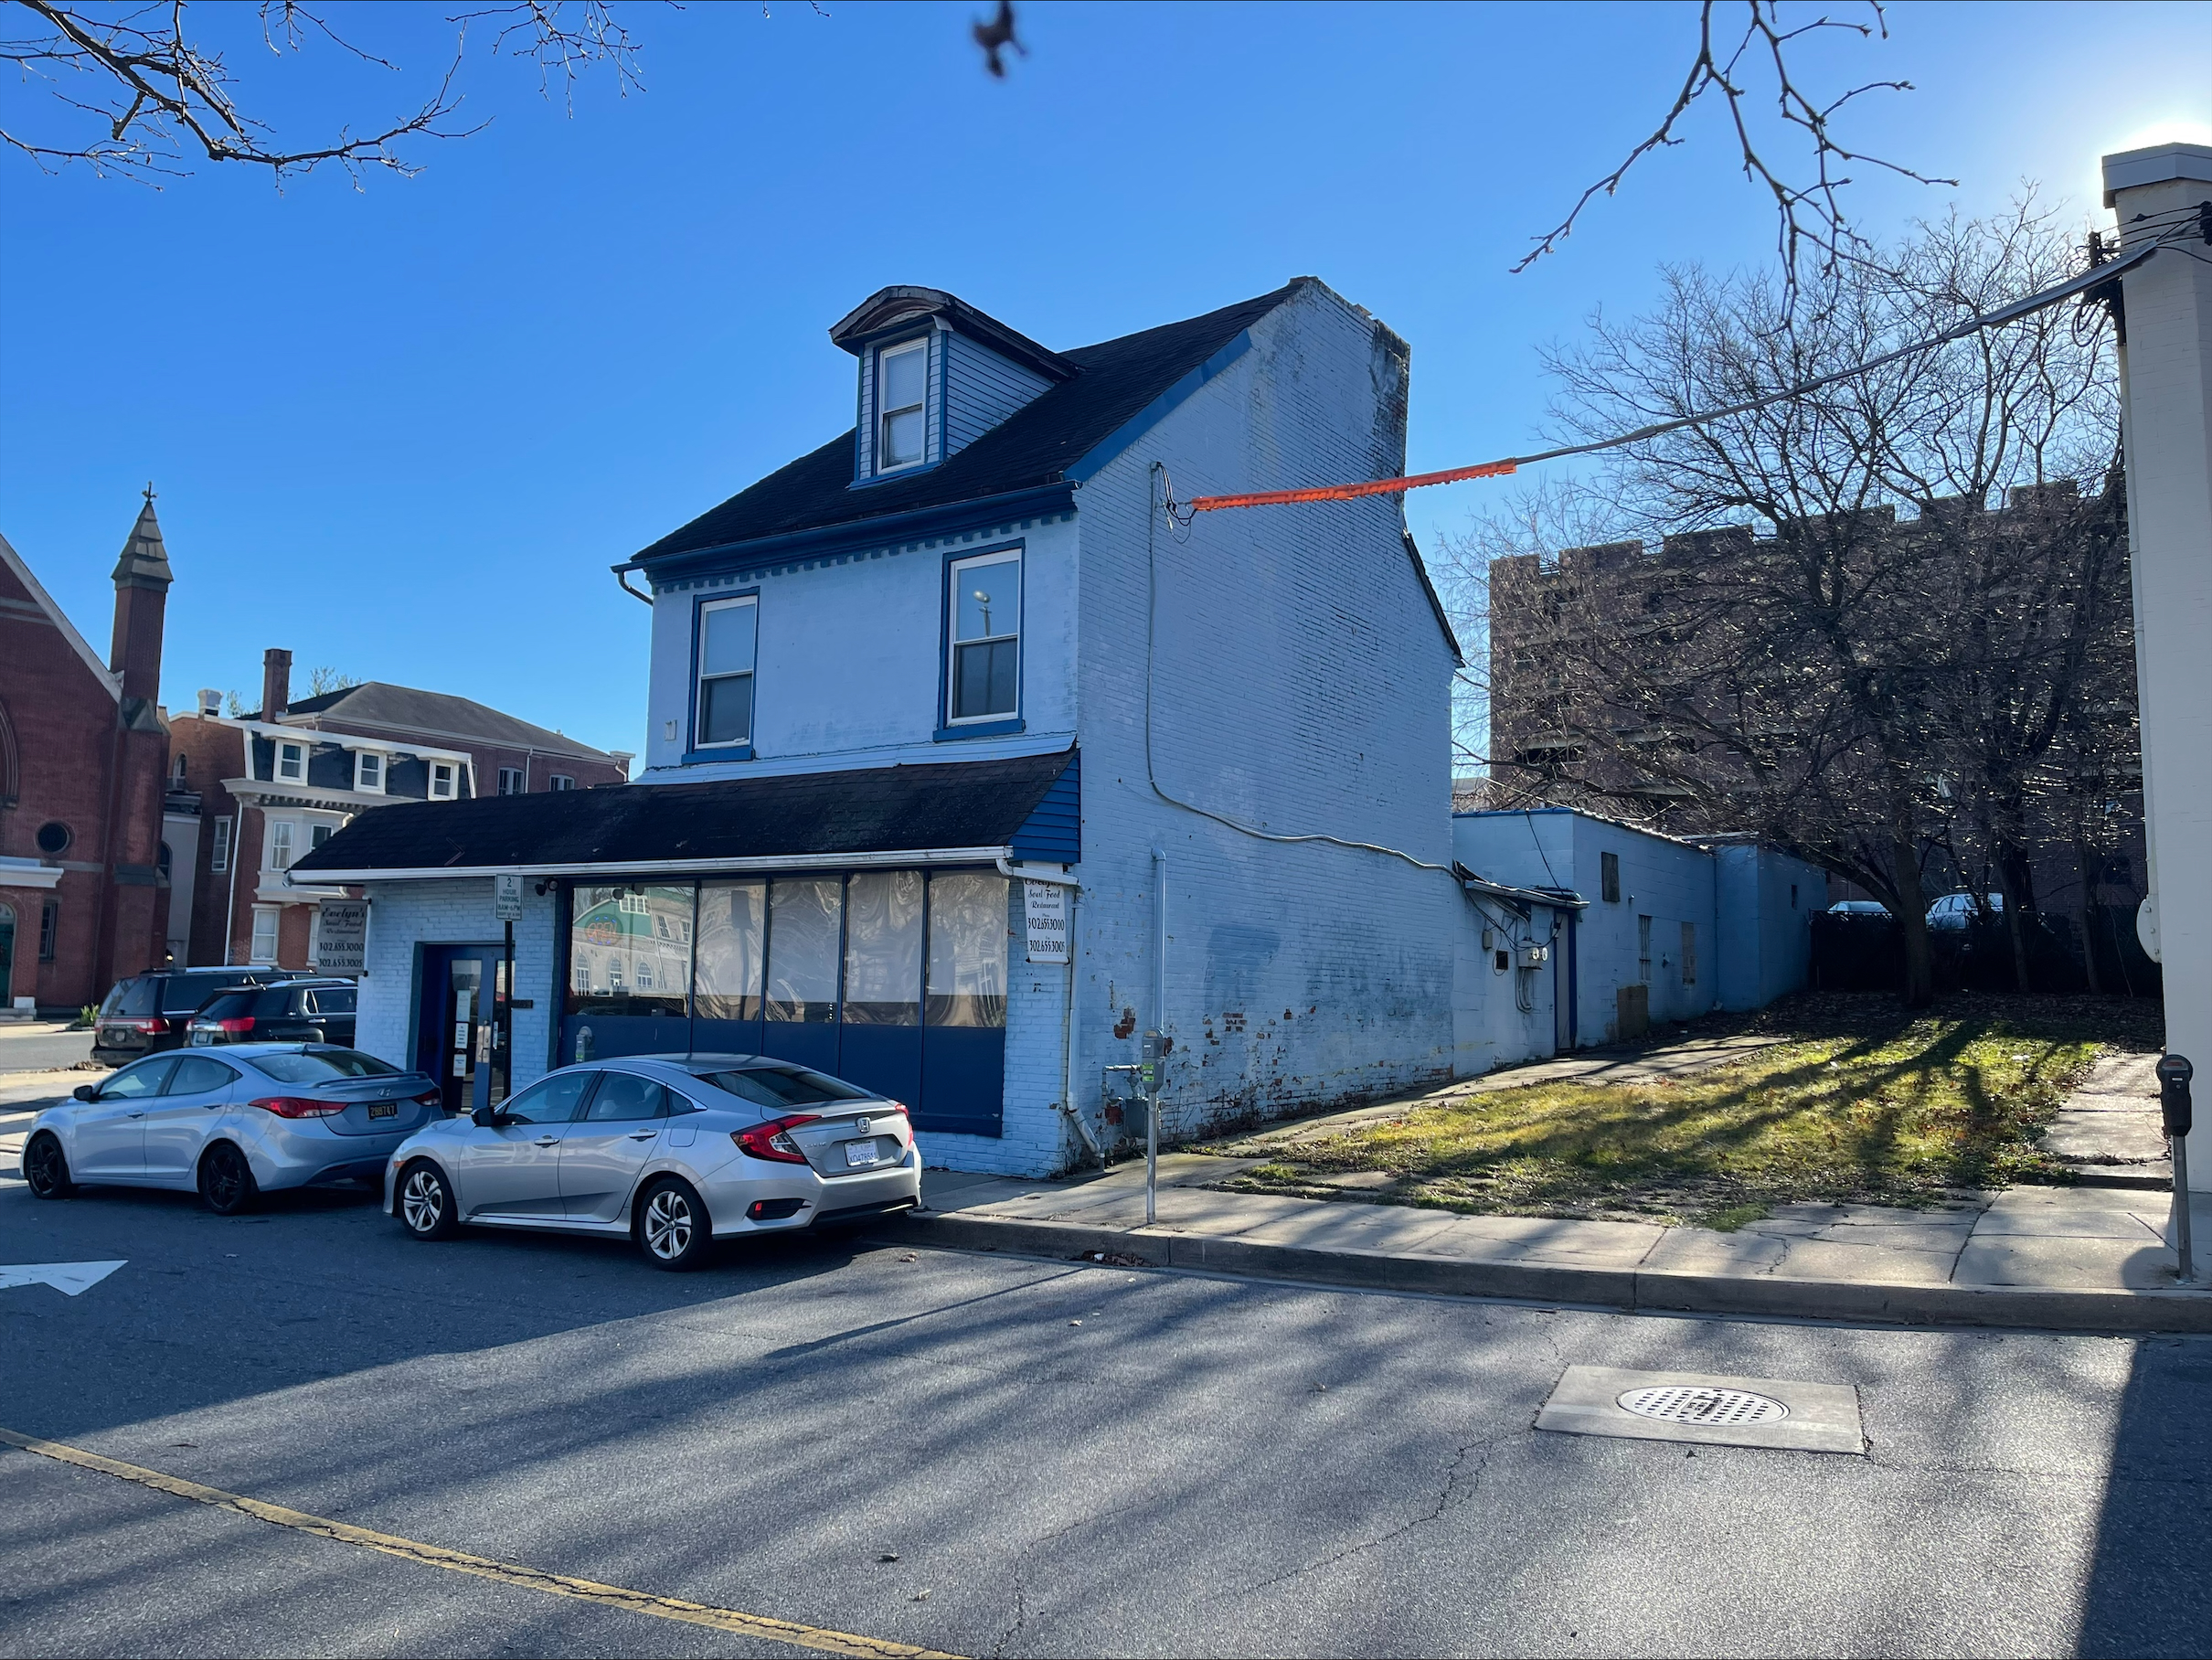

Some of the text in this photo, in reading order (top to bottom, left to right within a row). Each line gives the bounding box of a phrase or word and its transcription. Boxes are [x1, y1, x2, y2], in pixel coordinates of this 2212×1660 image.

[506, 877, 512, 888] 2
[499, 895, 519, 903] PARKING
[1027, 889, 1061, 900] Soul Food
[322, 907, 365, 920] Evelyn's
[324, 919, 363, 928] Soul Food
[586, 921, 618, 942] OPEN
